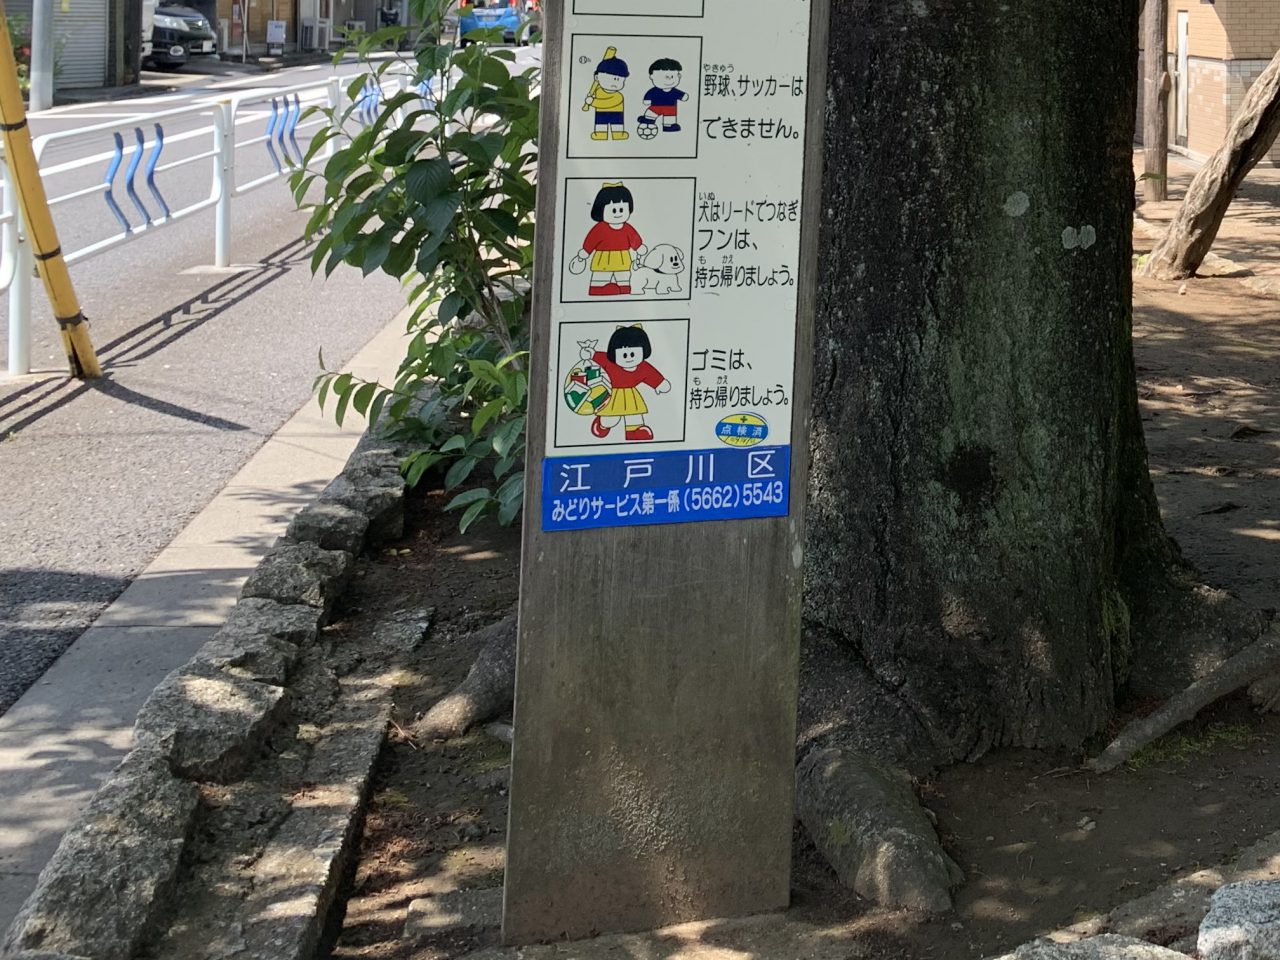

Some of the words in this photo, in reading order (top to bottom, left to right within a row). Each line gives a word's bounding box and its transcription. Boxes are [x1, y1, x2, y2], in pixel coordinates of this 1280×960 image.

[703, 74, 804, 97] 野球、サッカーは
[702, 116, 799, 139] できません。
[698, 200, 799, 222] 犬はリードでつなぎ
[698, 228, 758, 250] フンは、
[694, 264, 794, 288] 持ち帰りましょう。
[691, 348, 753, 371] ゴミは、
[689, 384, 789, 410] 持ち帰りましょう。
[560, 449, 776, 493] 江戸川区
